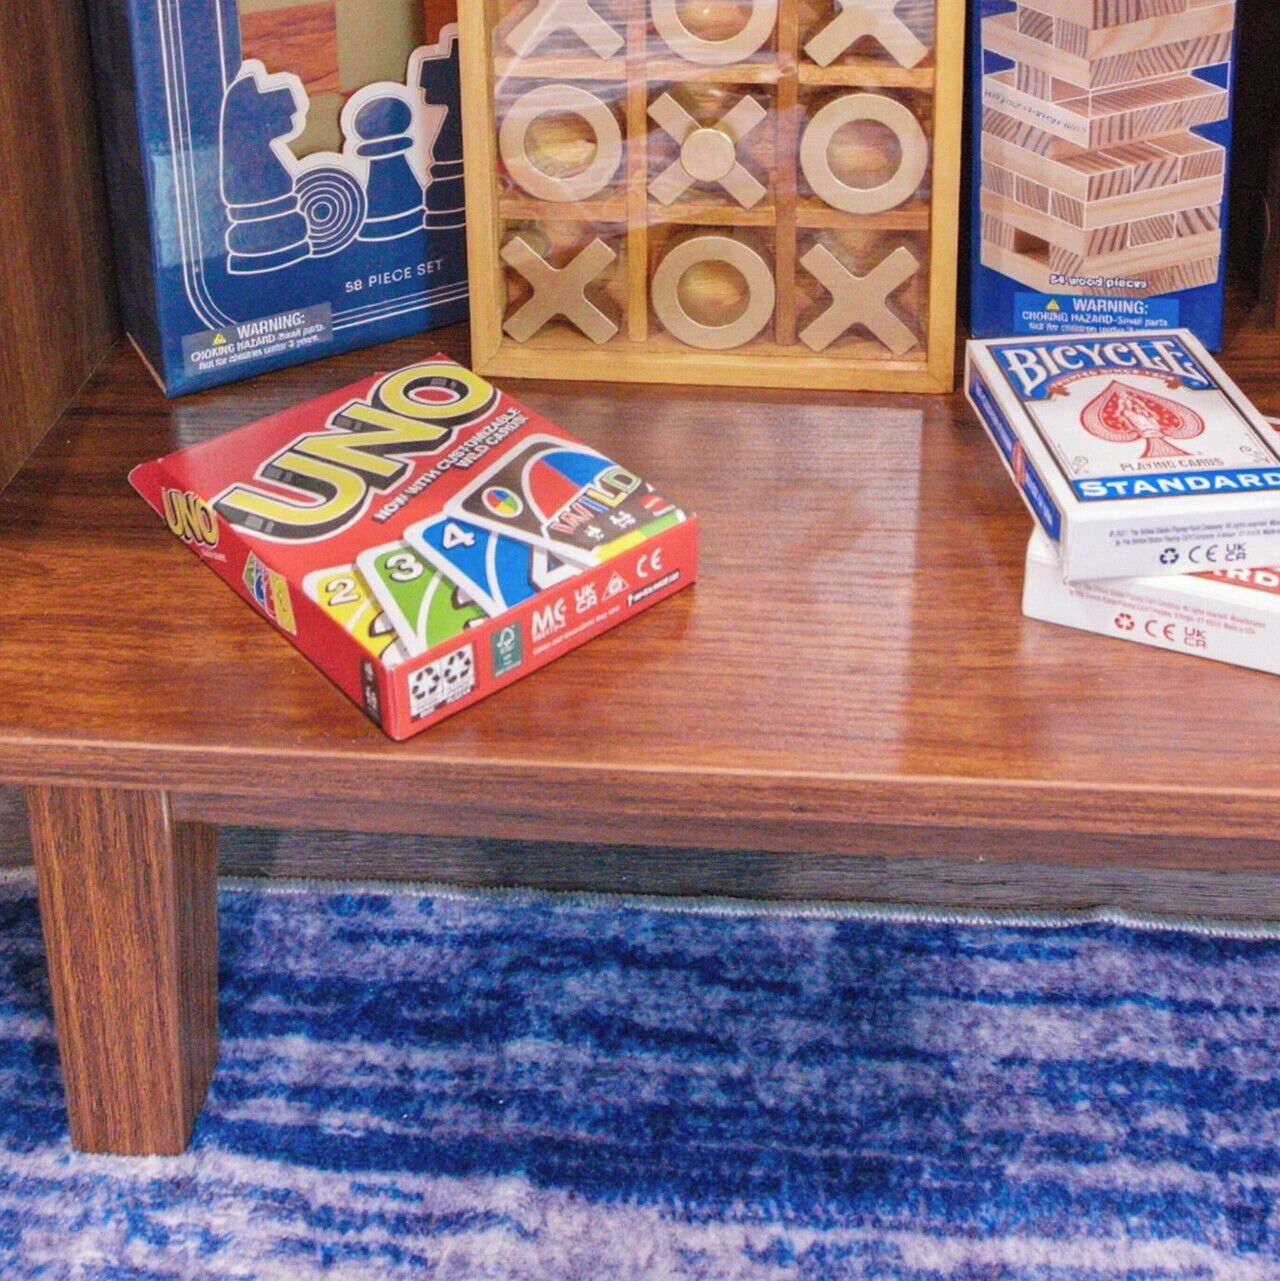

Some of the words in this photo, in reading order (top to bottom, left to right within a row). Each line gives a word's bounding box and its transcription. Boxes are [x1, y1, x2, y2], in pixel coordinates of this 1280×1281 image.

[345, 279, 363, 293] 58
[368, 267, 412, 287] PIECE
[417, 259, 444, 276] SET
[1067, 275, 1104, 288] wood
[1072, 297, 1149, 315] WARNING:
[237, 312, 306, 339] WARNING:
[1002, 339, 1210, 397] BICYCLE
[214, 361, 502, 543] UNO
[373, 490, 409, 521] NOW
[407, 469, 442, 496] WITH
[436, 407, 521, 471] CUSTOMIZABLE
[454, 443, 490, 468] WILD
[1120, 460, 1176, 472] PLAYING
[1179, 457, 1225, 469] CARDS
[549, 468, 642, 535] WILD
[161, 486, 220, 550] UNO
[442, 522, 476, 550] 4
[384, 553, 424, 583] 3
[324, 577, 361, 607] 2
